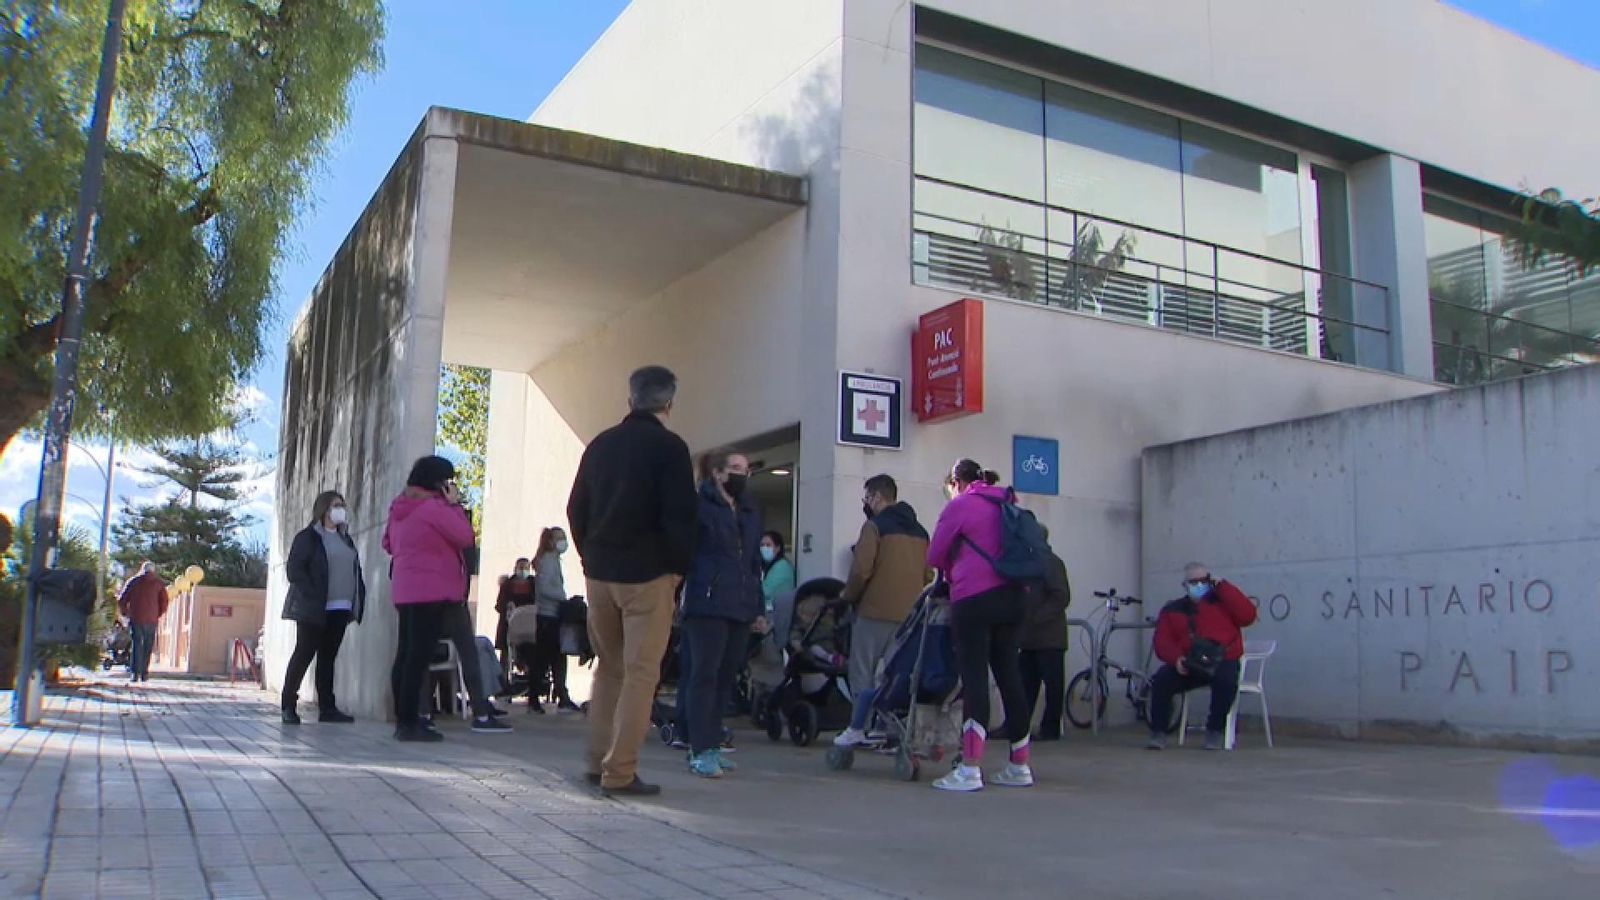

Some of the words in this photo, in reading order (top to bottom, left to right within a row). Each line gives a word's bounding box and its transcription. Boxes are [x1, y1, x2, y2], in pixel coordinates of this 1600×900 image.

[934, 327, 953, 350] PAC
[1321, 579, 1553, 620] SANITARIO
[1399, 650, 1573, 694] PAIP
